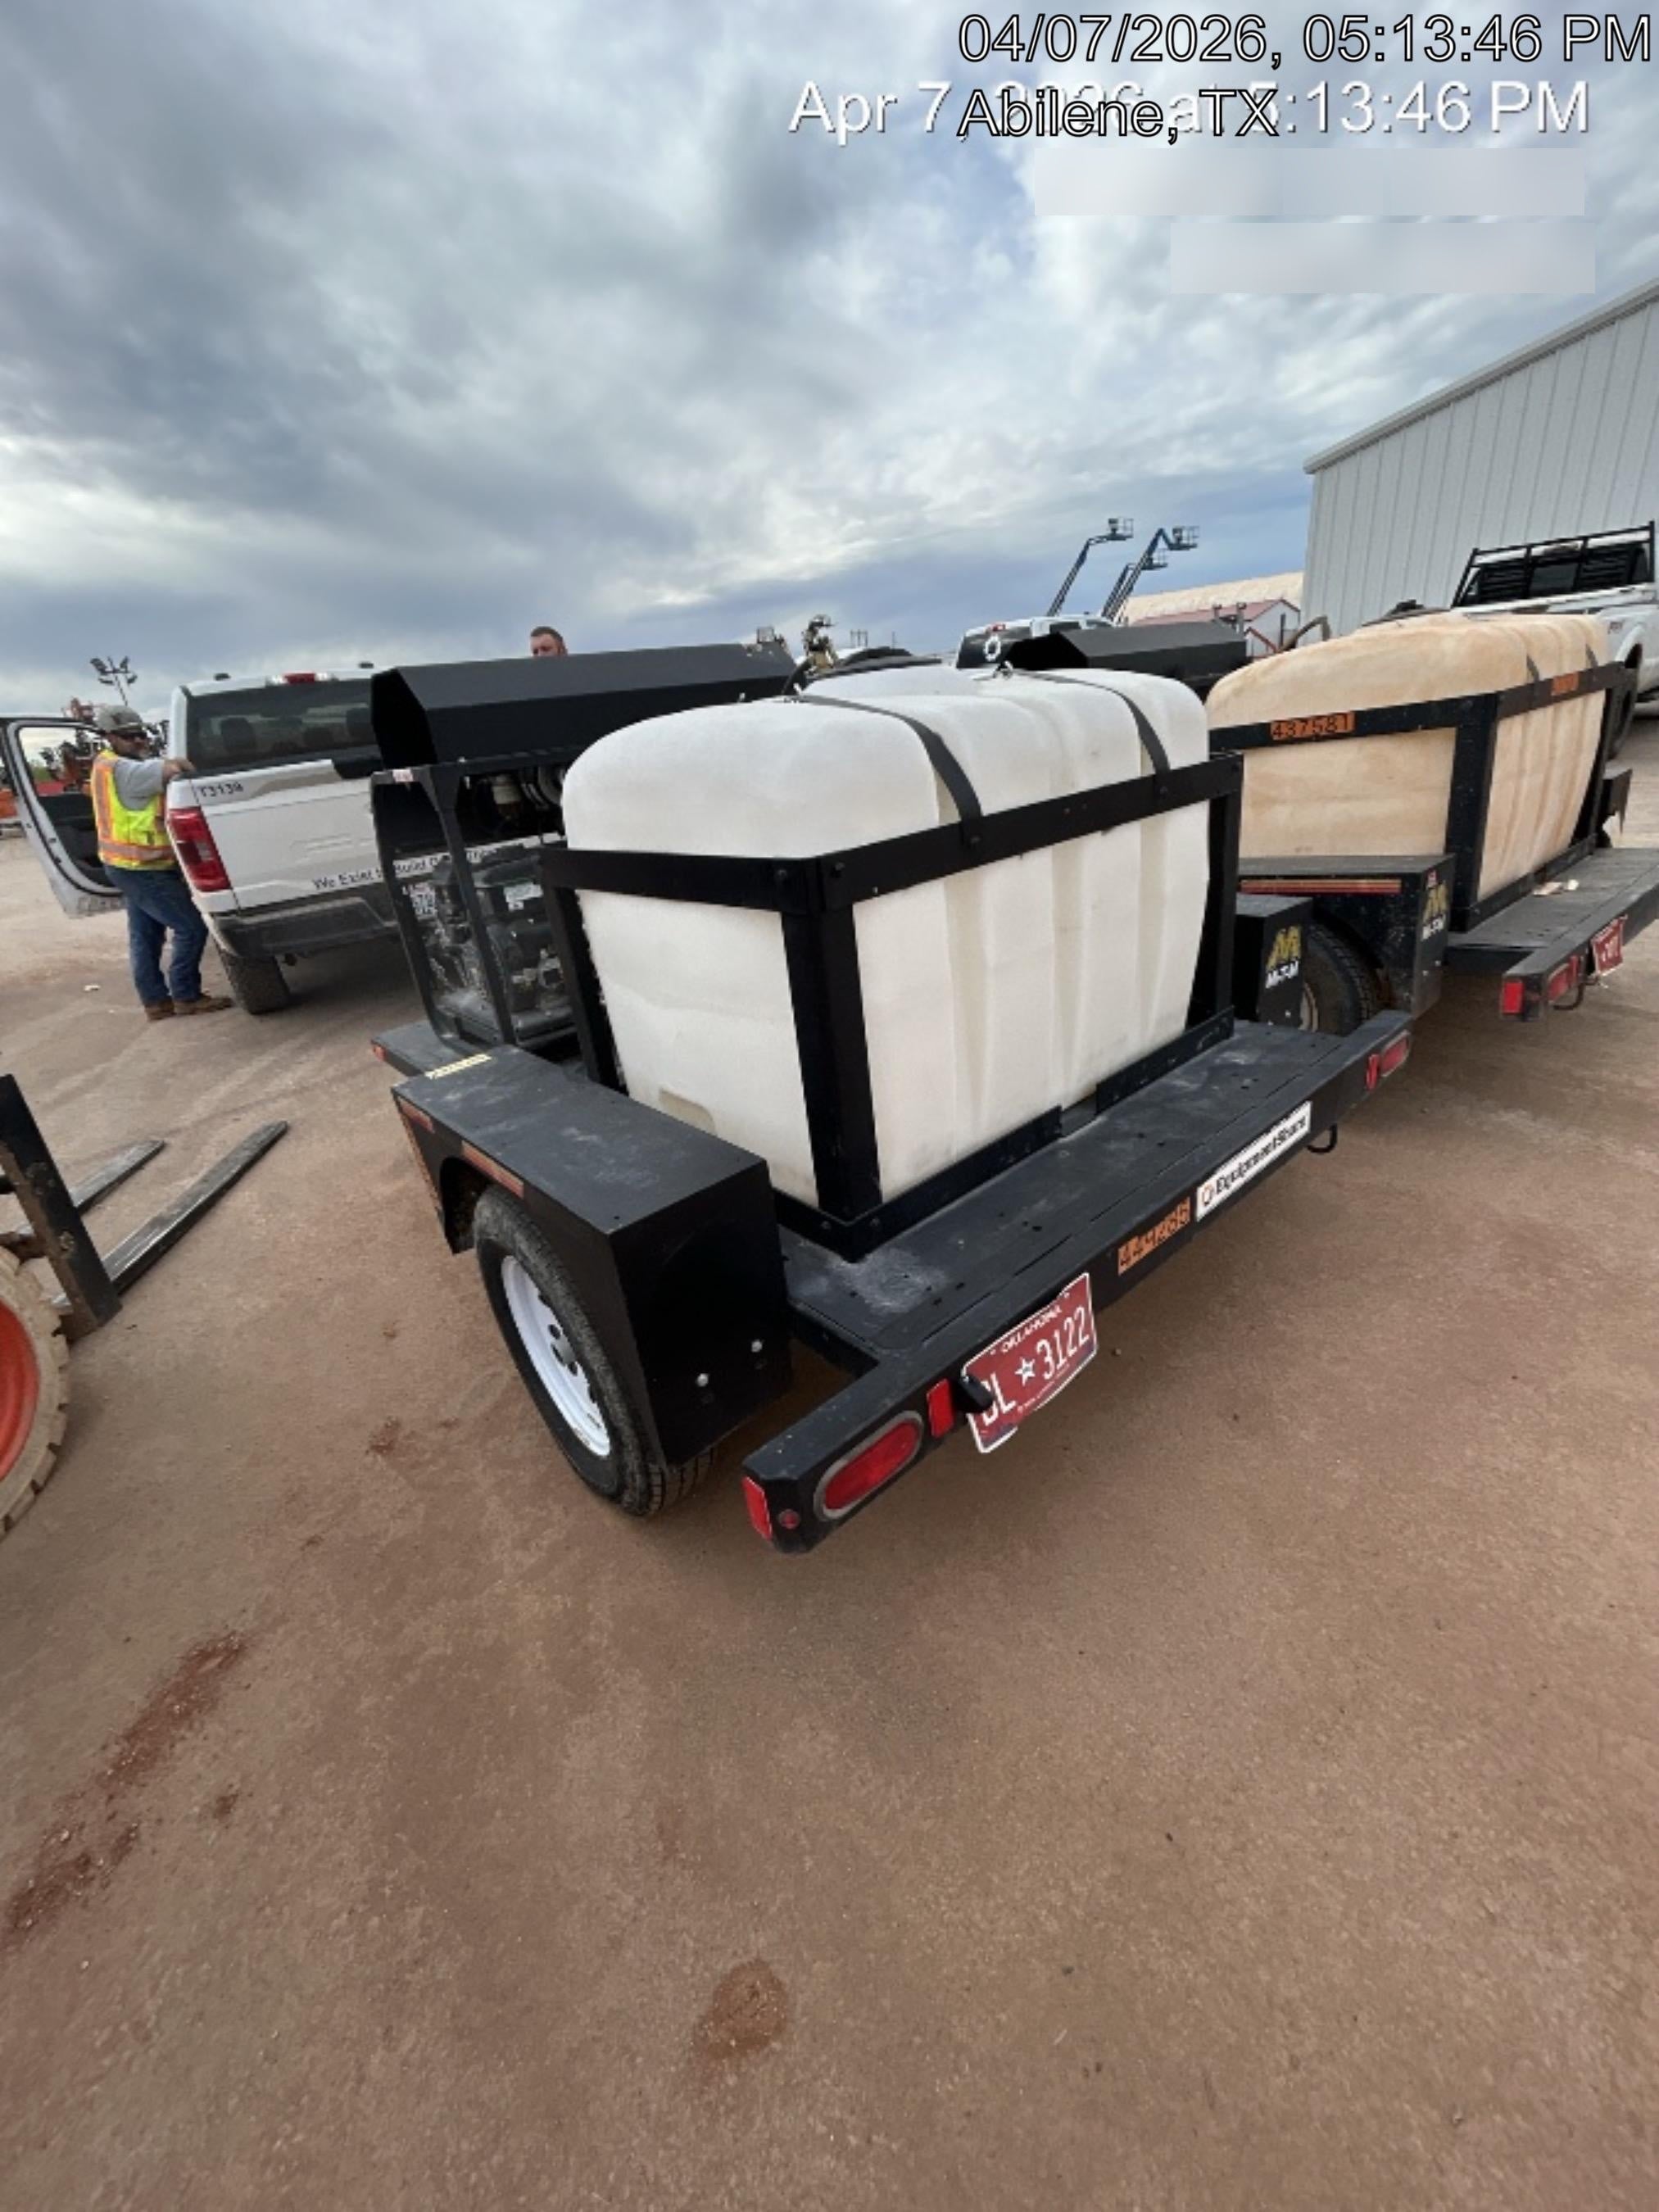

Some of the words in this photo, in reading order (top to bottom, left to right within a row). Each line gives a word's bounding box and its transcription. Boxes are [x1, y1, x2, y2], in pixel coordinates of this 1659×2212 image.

[1271, 712, 1349, 738] 437581
[1002, 1303, 1063, 1353] OKLAHOMA
[1036, 1304, 1090, 1380] 3122
